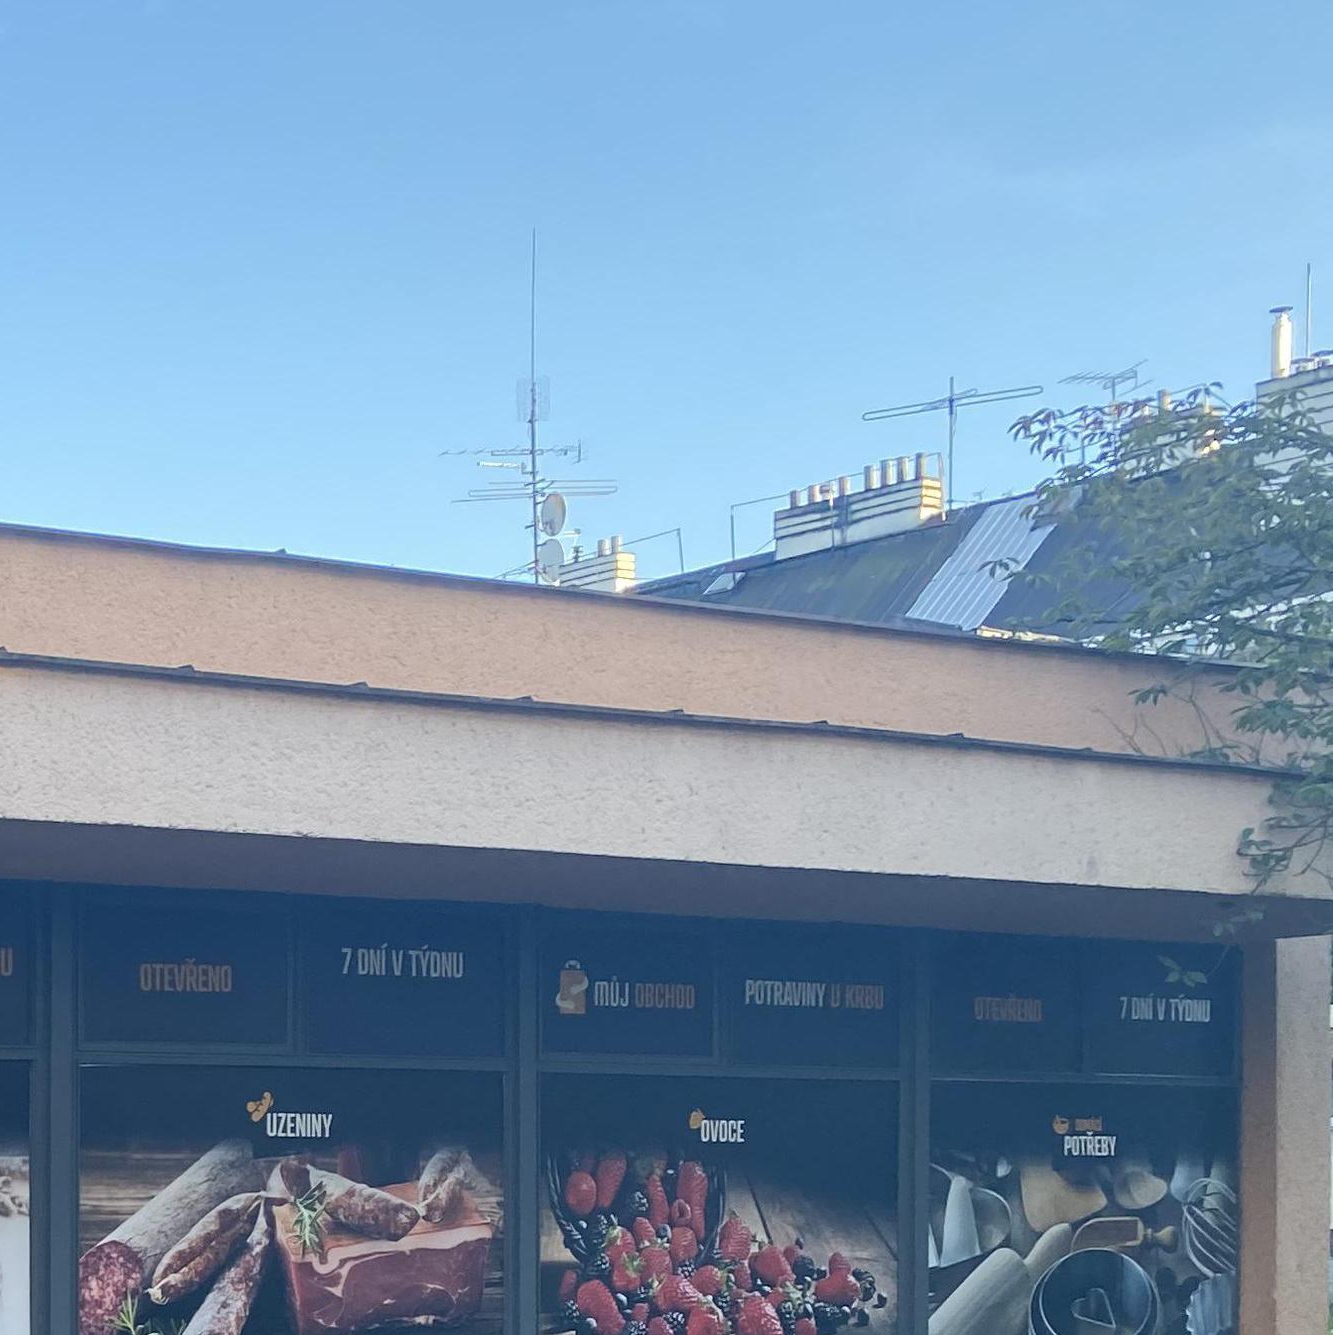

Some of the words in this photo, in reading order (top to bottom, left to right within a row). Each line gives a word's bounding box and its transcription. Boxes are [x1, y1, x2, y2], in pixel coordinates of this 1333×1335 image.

[140, 958, 232, 993] OTEVŘENO
[342, 948, 352, 975] 7
[358, 944, 387, 976] DNÍ
[392, 950, 403, 977] V
[408, 945, 464, 979] TÝDNU
[594, 976, 630, 1007] MŮJ
[635, 982, 694, 1009] OBCHOD
[745, 979, 826, 1008] POTRAVINY
[1120, 996, 1128, 1020] 7
[1132, 994, 1154, 1021] DNÍ
[1157, 998, 1165, 1021] V
[1169, 995, 1211, 1023] TÝDNU
[266, 1113, 332, 1138] UZENINY
[700, 1119, 745, 1143] OVOCE
[1064, 1131, 1117, 1157] POTŘEBY
